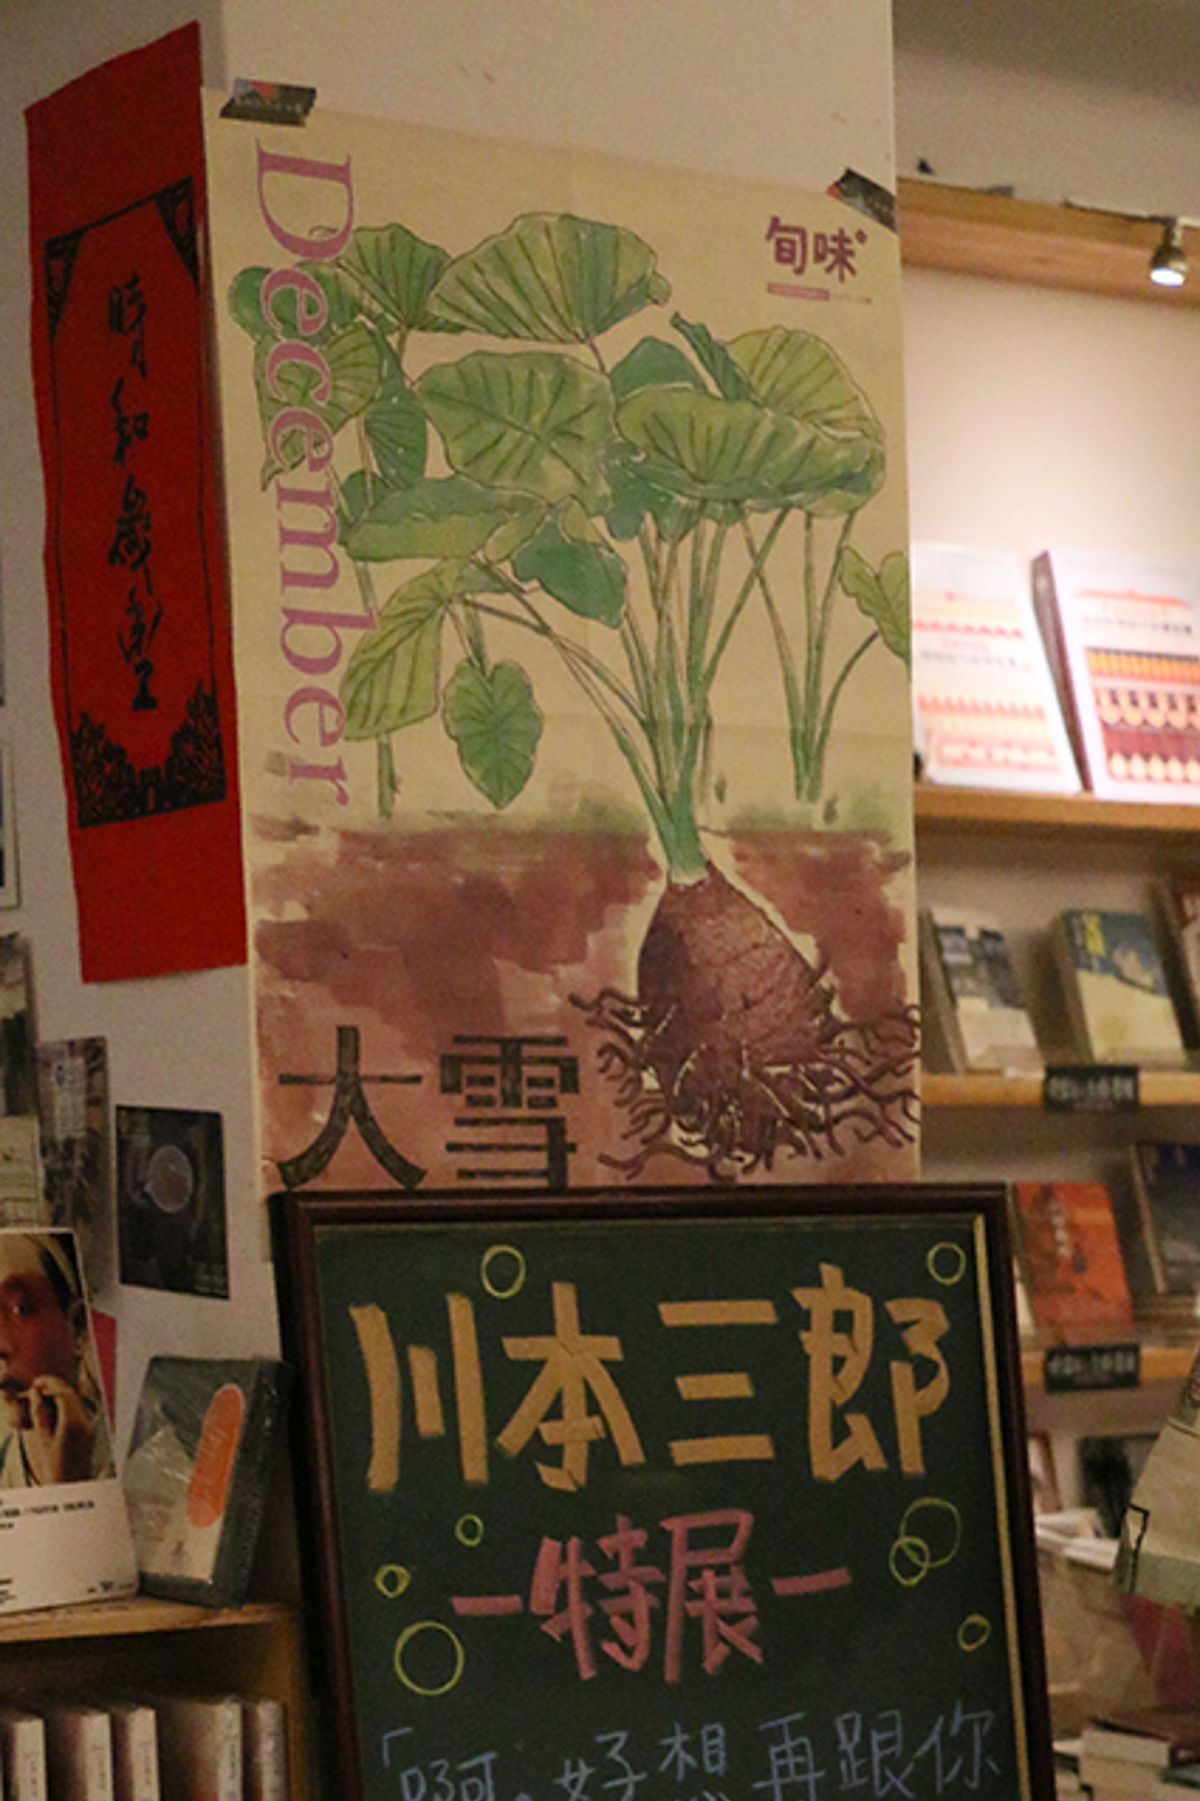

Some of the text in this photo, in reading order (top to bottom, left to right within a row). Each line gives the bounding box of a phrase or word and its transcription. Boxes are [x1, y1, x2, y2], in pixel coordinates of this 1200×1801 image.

[765, 215, 857, 284] 旬味
[256, 138, 378, 805] December
[277, 1024, 580, 1192] 大雪
[351, 1263, 951, 1493] 川本三郎
